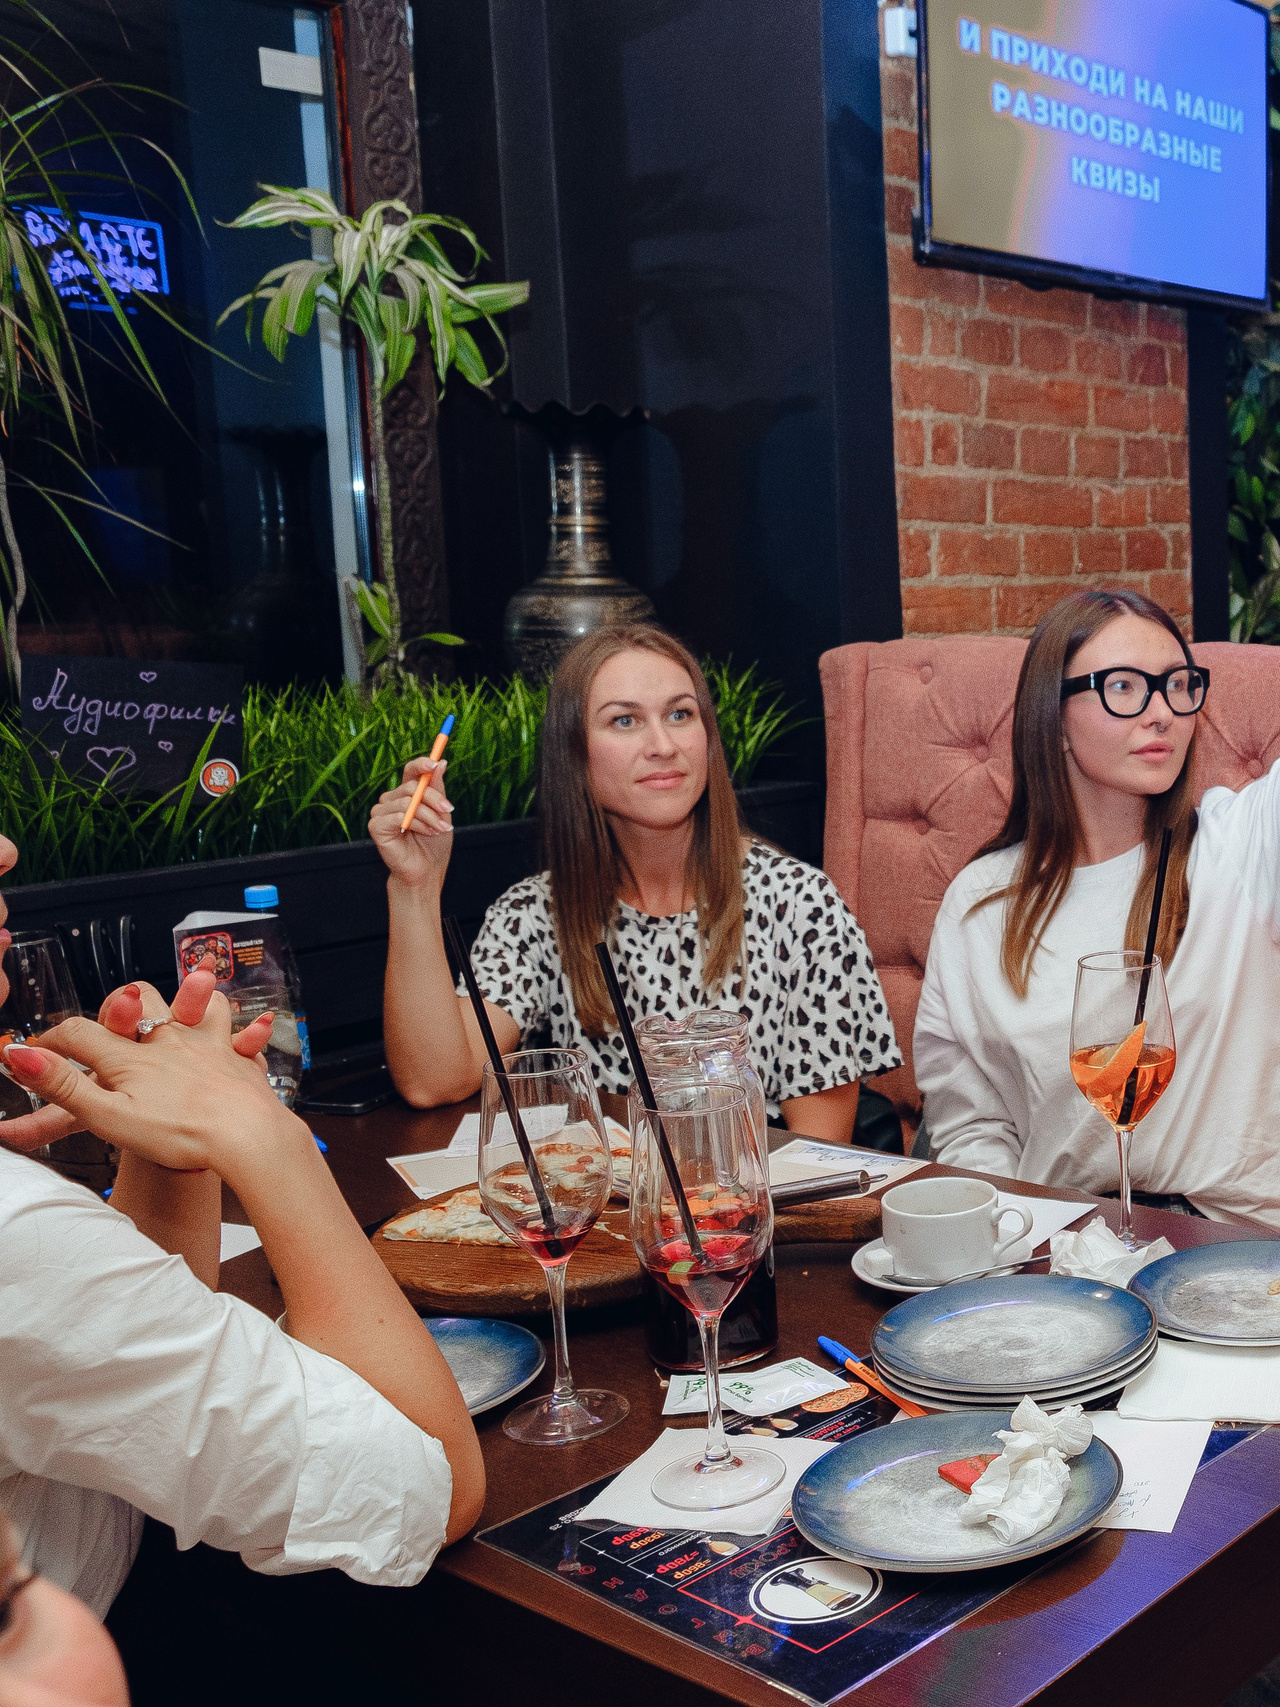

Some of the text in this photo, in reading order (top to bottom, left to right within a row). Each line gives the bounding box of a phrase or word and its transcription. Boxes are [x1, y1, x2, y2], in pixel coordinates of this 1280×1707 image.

[958, 18, 1245, 135] И ПРИХОДИ НА НАШИ
[992, 82, 1223, 174] РАЗНООБРАЗНЫЕ
[1070, 155, 1161, 204] КВИЗЫ
[32, 667, 236, 736] Аудиофилки
